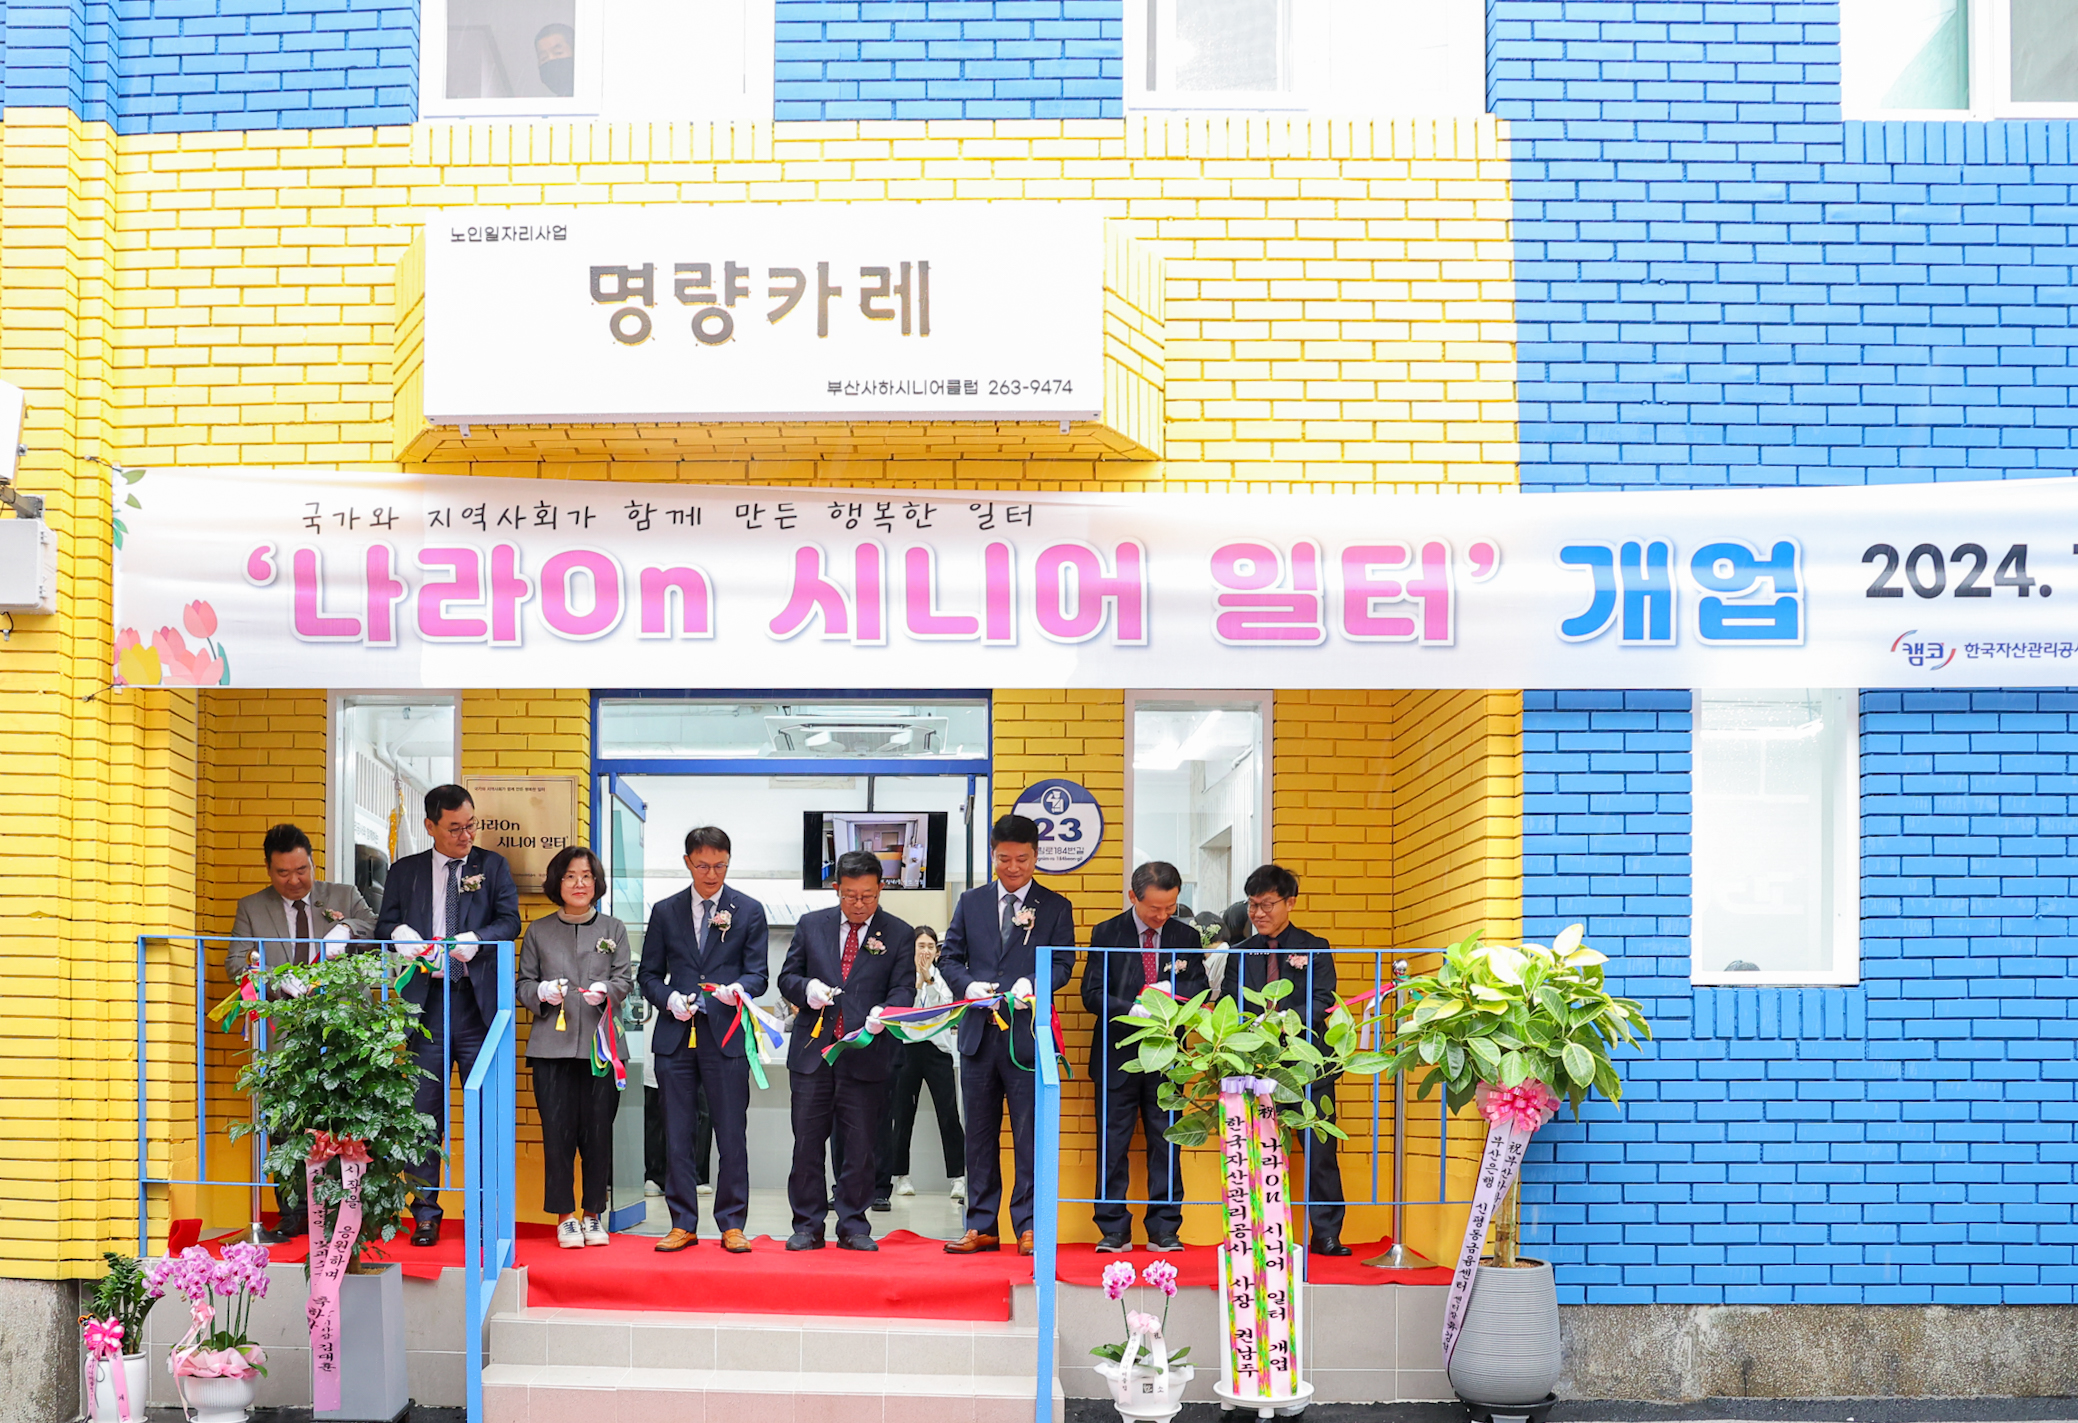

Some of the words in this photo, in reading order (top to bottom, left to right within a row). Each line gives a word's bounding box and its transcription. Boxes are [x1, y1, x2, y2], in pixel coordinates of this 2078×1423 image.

[450, 225, 568, 243] 노인일자리사업
[589, 261, 931, 345] 명량카레
[826, 379, 979, 396] 부산사하시니어클럽
[988, 380, 1073, 395] 263-9474
[302, 501, 399, 534] 국가와
[428, 500, 597, 531] 지역사회가
[624, 499, 702, 532] 함께
[736, 502, 798, 530] 만든
[828, 500, 937, 533] 행복한
[968, 501, 1034, 530] 일터
[768, 541, 1146, 643] 시니어
[1558, 539, 1803, 641] 개업
[1862, 542, 2052, 599] 2024.
[1902, 642, 1944, 666] 캠코
[496, 836, 536, 849] 시니어
[1035, 817, 1083, 842] 23
[1037, 846, 1084, 855] 림로184번길
[1258, 1104, 1275, 1121] 祝
[1482, 1136, 1504, 1189] 부산은행
[344, 1163, 361, 1210] 시작을
[1225, 1116, 1252, 1256] 한국자산관리공사
[325, 1225, 355, 1281] 응원하며
[1263, 1222, 1285, 1272] 시니어
[1232, 1275, 1255, 1309] 사장
[1267, 1289, 1287, 1320] 일터
[1234, 1327, 1259, 1378] 권남주
[1269, 1340, 1288, 1372] 개업
